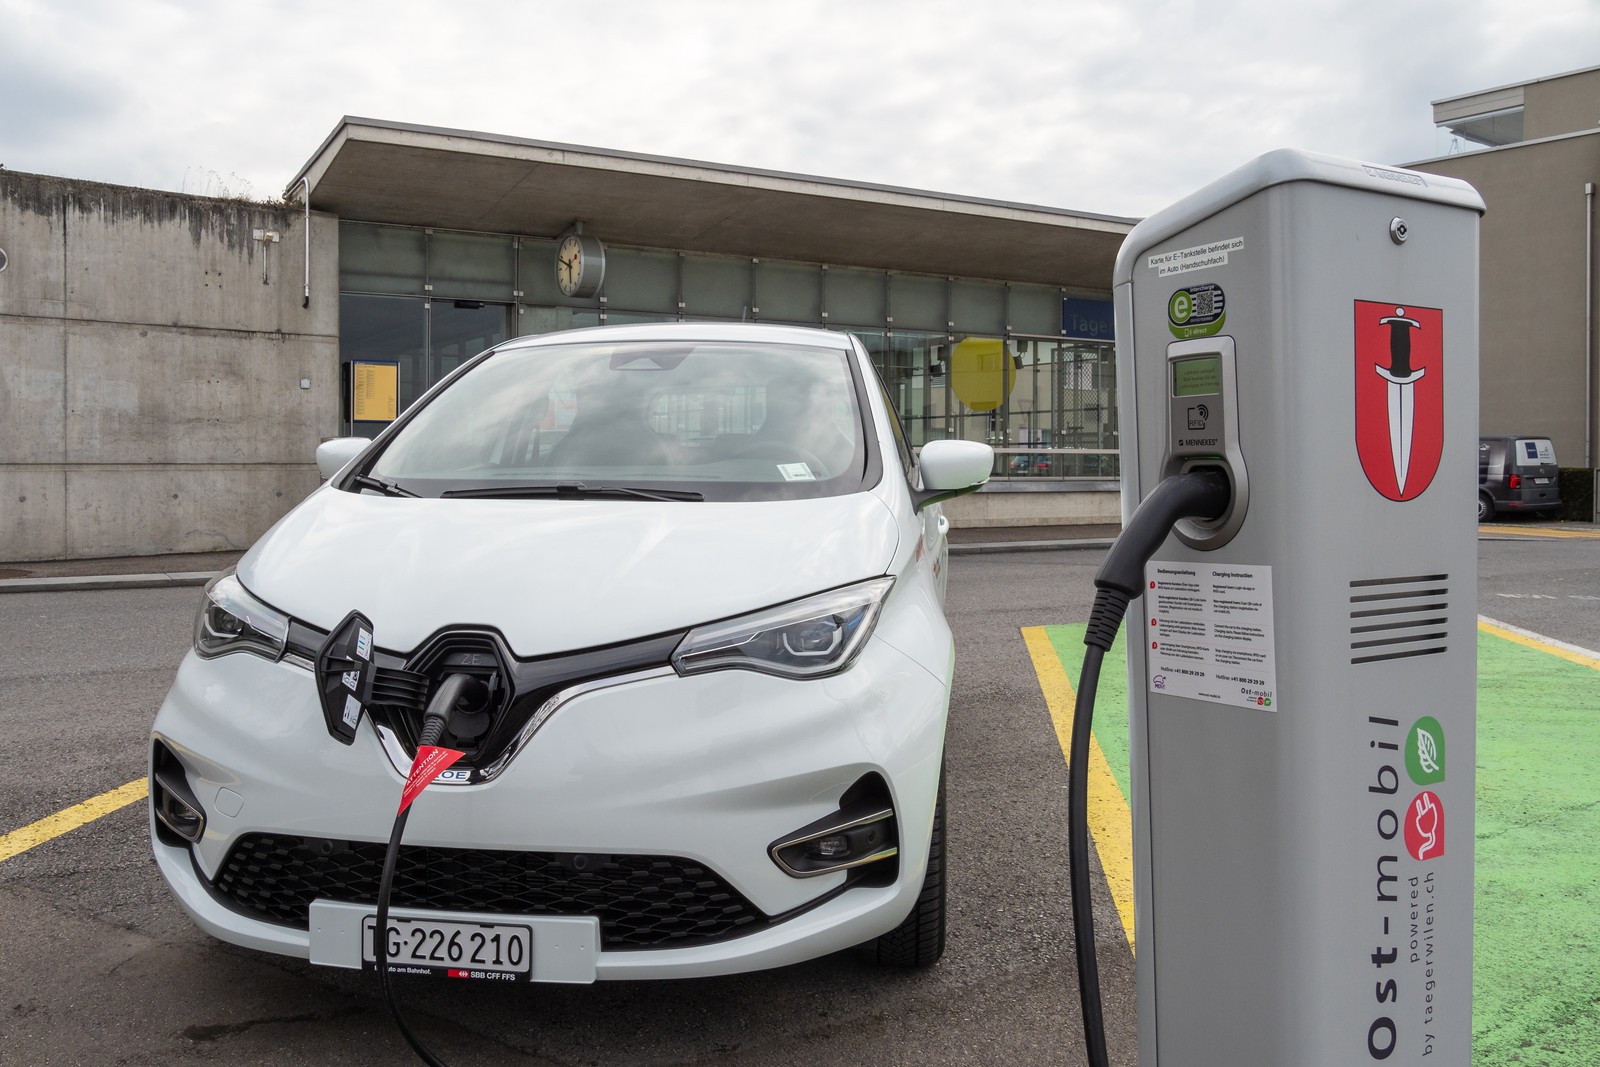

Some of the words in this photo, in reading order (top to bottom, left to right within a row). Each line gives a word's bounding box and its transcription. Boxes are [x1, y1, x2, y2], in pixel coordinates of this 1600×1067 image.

[1173, 247, 1207, 260] E-Tankstelle
[1208, 243, 1230, 253] befindet
[1231, 240, 1243, 248] sich
[1167, 266, 1179, 274] Auto
[1180, 256, 1224, 271] (Handschuhfach)
[1241, 688, 1272, 698] Ost-mobil
[406, 748, 438, 785] ATTENTION
[437, 771, 467, 780] OE
[1367, 716, 1399, 1060] Ost-mobil
[1409, 876, 1419, 963] powered
[470, 932, 523, 966] 210
[1423, 871, 1436, 1025] taegerwilen.ch
[1422, 1033, 1436, 1057] by
